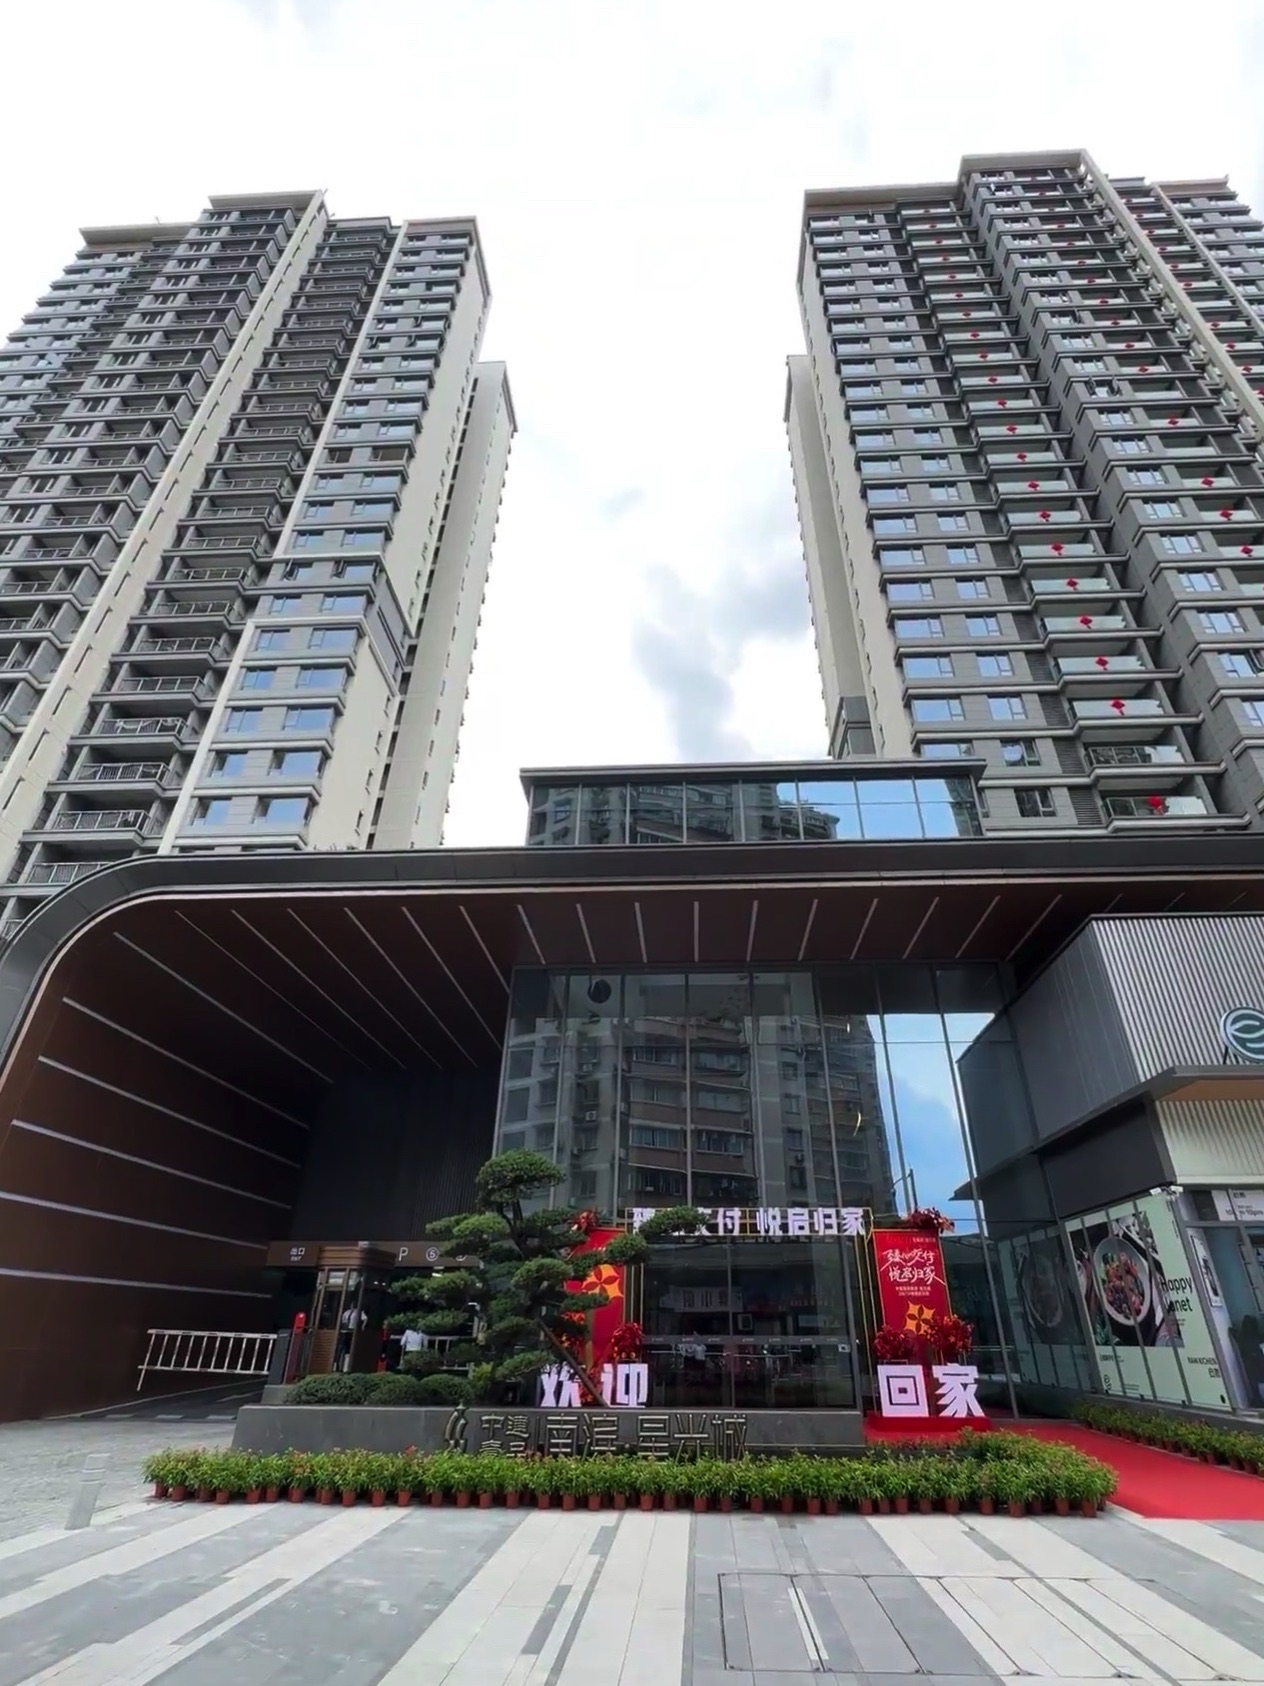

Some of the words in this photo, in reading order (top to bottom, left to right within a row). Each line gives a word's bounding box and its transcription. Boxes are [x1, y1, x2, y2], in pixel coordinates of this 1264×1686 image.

[756, 1207, 867, 1236] 悦启归家
[1160, 1276, 1193, 1295] Happy
[541, 1362, 648, 1408] 欢迎
[877, 1363, 986, 1418] 回家
